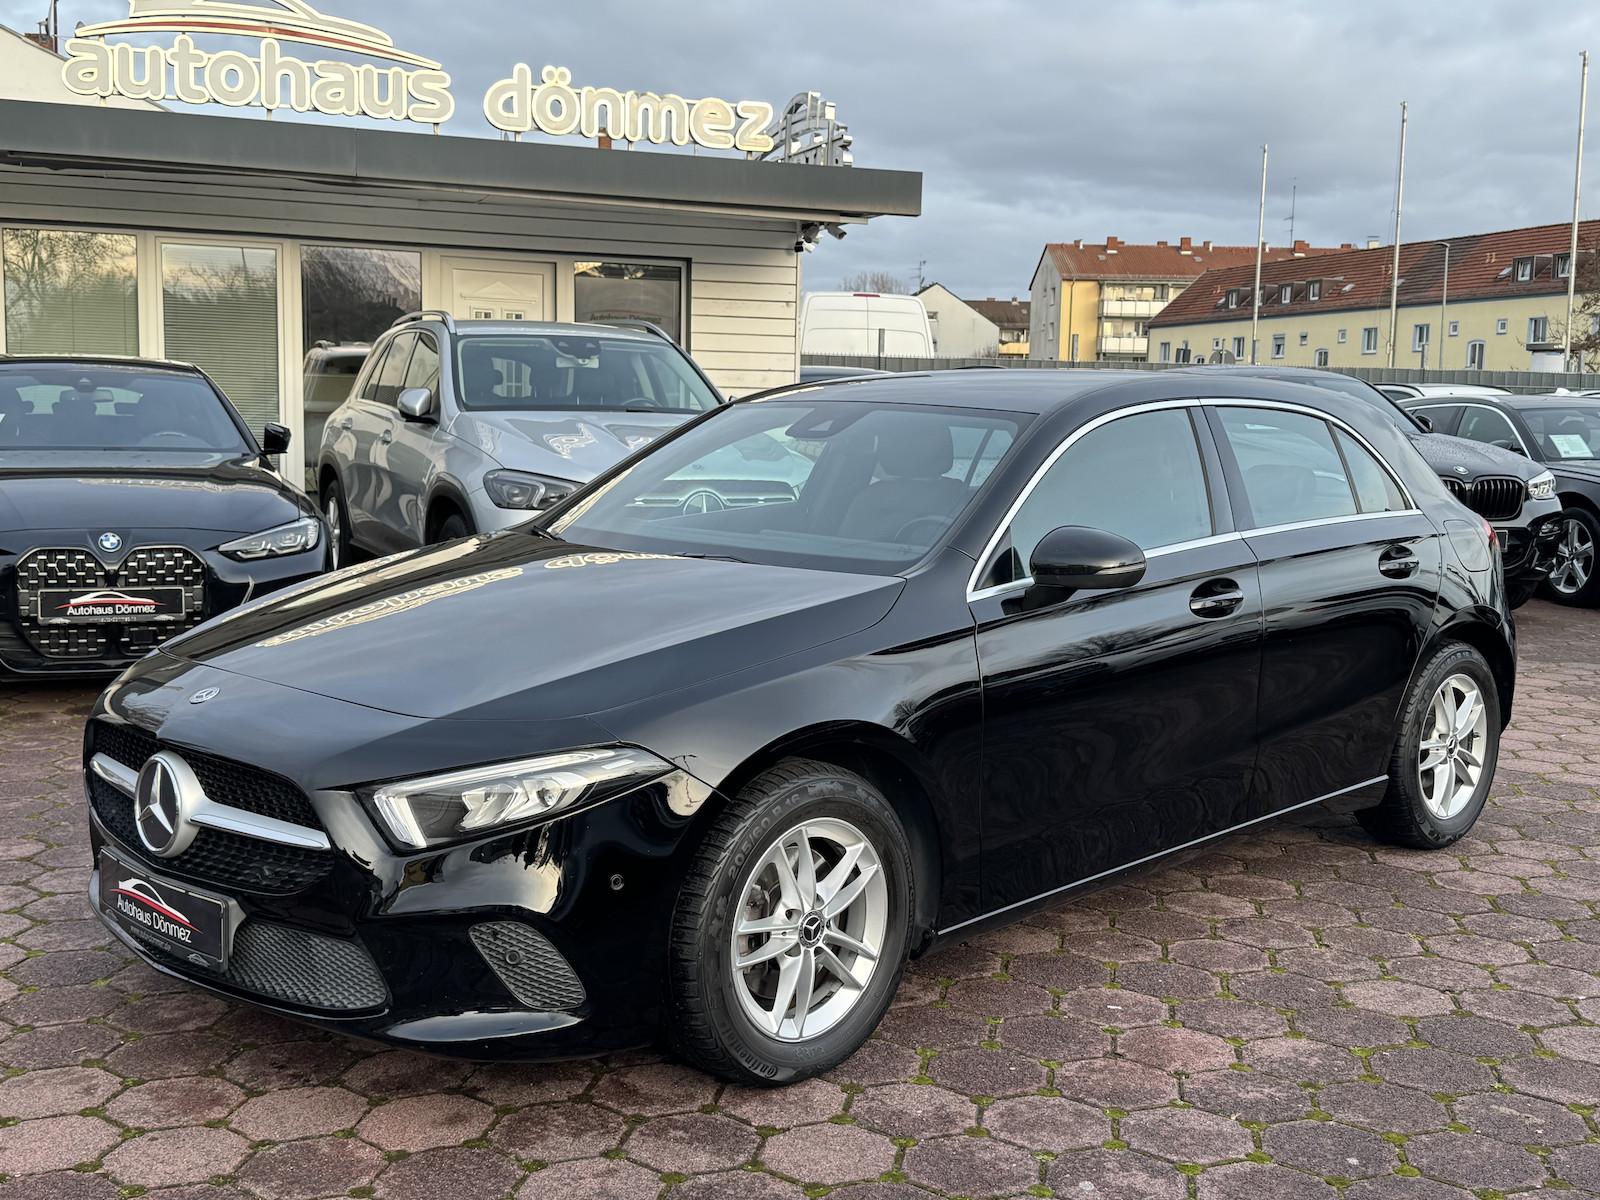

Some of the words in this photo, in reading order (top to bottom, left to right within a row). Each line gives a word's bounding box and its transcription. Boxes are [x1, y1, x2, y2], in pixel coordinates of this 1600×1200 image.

[62, 34, 455, 123] autohaus
[483, 63, 774, 152] dönmez
[67, 604, 114, 616] Autohaus
[115, 603, 156, 615] Dönmez
[117, 893, 152, 926] Autohaus
[153, 911, 192, 943] Dönmez
